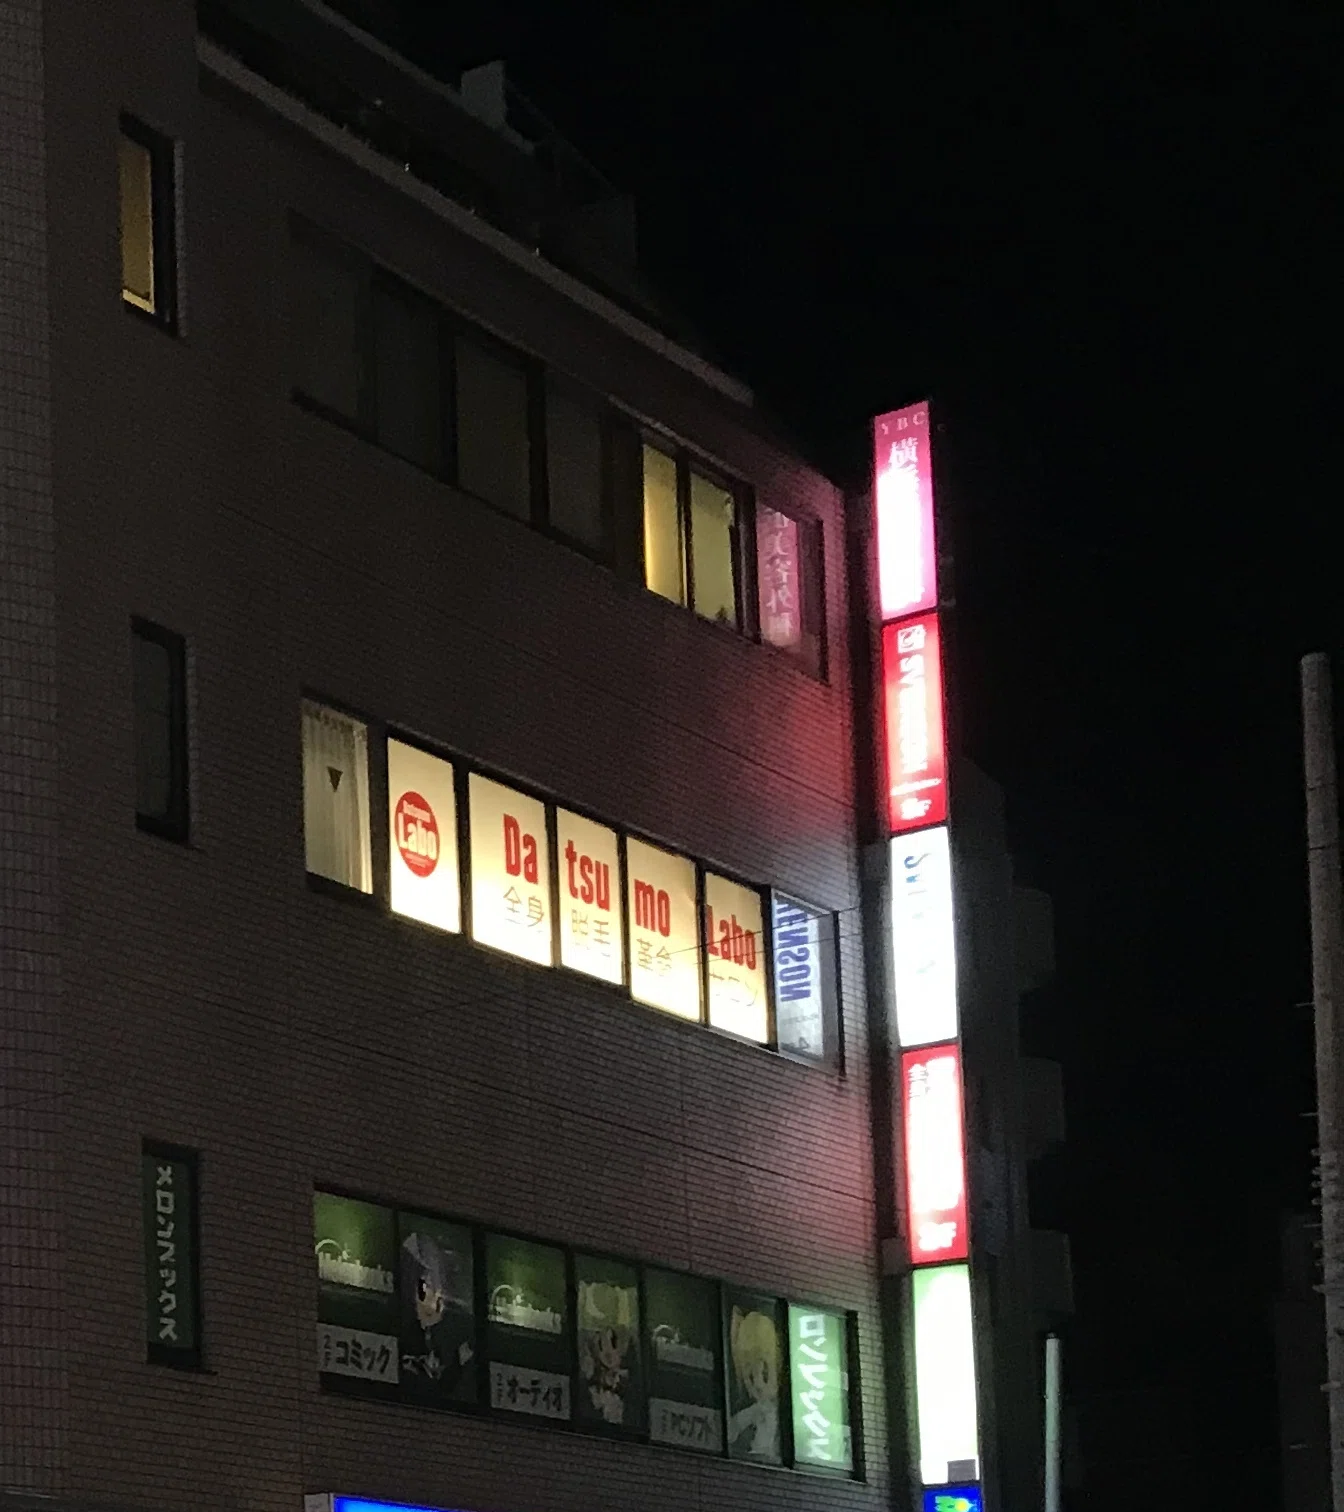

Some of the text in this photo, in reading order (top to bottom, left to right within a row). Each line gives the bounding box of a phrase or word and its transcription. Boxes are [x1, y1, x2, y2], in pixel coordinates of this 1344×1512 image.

[503, 813, 539, 886] Da
[564, 839, 610, 913] tsu
[634, 877, 672, 938] mo
[706, 905, 757, 971] Labo
